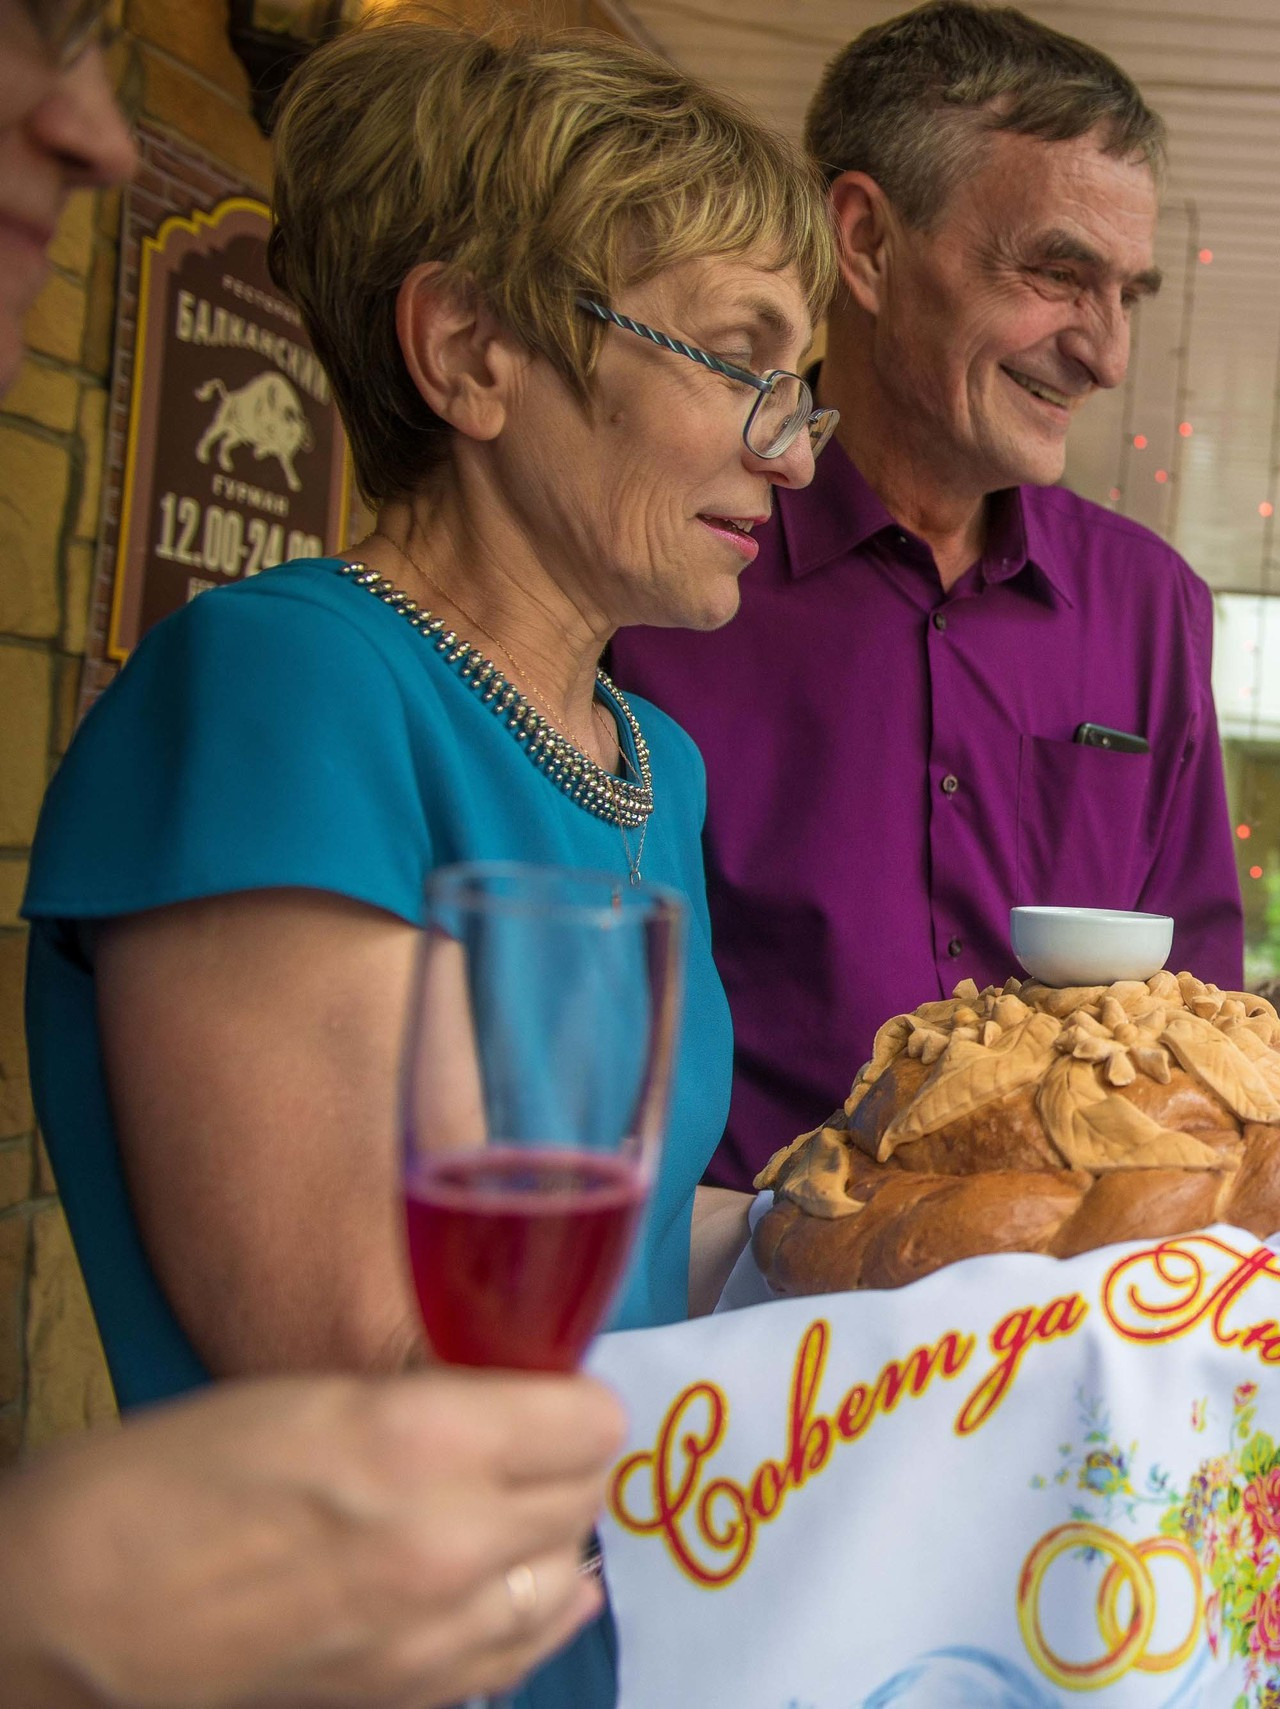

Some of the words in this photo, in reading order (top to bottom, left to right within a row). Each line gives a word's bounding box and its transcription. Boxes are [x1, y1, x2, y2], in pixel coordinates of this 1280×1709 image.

[155, 491, 323, 577] 12.00-24
[212, 474, 289, 517] ГУРМАН
[607, 1319, 975, 1588] Совет
[953, 1290, 1088, 1437] да
